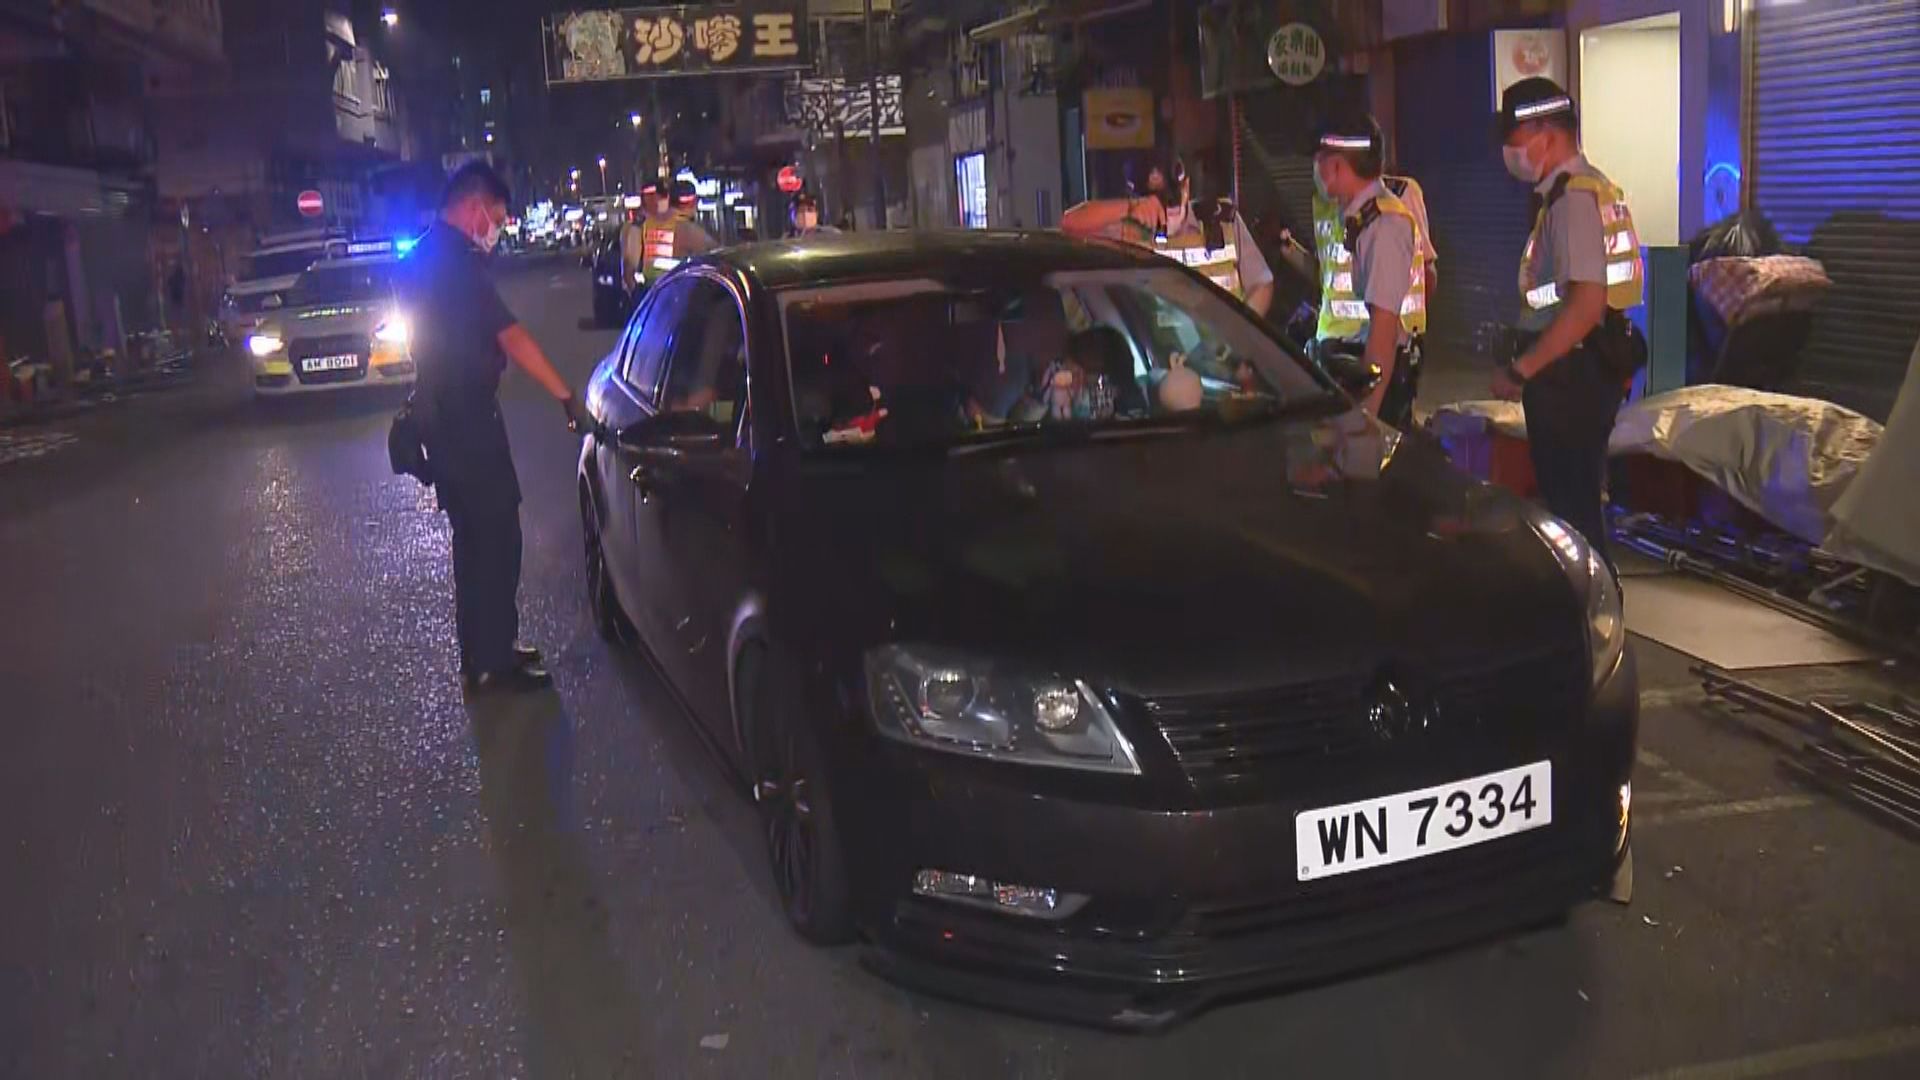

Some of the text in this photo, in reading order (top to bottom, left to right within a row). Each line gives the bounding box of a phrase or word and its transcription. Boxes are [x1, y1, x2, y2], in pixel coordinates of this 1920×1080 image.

[306, 357, 323, 371] AM
[1317, 773, 1537, 866] WN 7334
